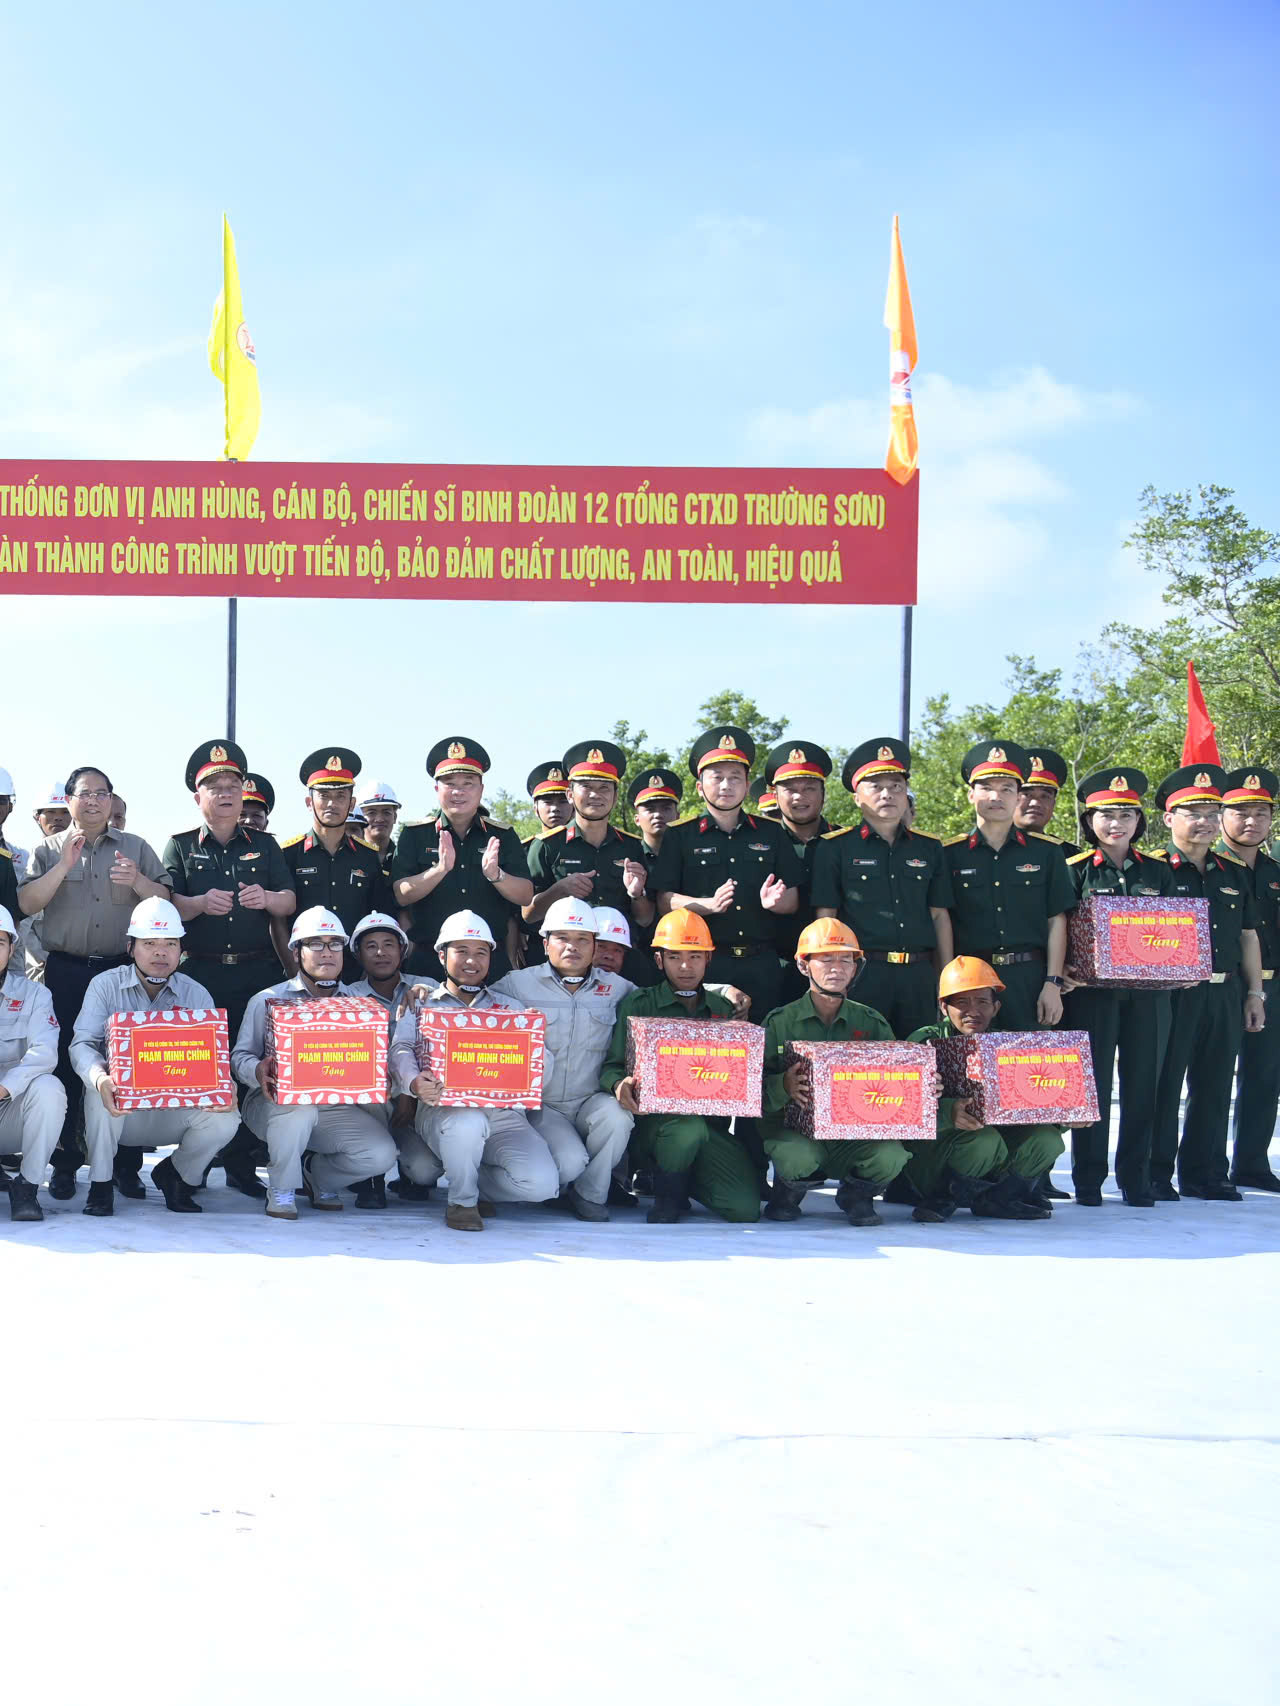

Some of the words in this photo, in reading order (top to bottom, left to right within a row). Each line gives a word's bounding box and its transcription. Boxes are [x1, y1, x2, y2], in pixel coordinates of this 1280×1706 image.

[0, 474, 67, 516] THỐNG
[75, 483, 118, 517] ĐƠN
[126, 487, 144, 524] VỊ
[152, 487, 195, 518] ANH
[202, 481, 265, 522] HÙNG,
[274, 482, 316, 519] CÁN
[323, 482, 356, 527] BỘ,
[364, 480, 427, 520] CHIẾN
[434, 485, 456, 521] SĨ
[462, 491, 512, 522] BINH
[518, 485, 576, 523] ĐOÀN
[584, 492, 608, 523] 12
[616, 480, 678, 527] (TỔNG
[685, 493, 738, 524] CTXD
[744, 486, 827, 525] TRƯỜNG
[834, 492, 885, 529] SƠN)
[35, 536, 104, 573] THÀNH
[112, 537, 168, 574] CÔNG
[176, 537, 237, 574] TRÌNH
[245, 541, 297, 582] VƯỢT
[303, 536, 349, 576] TIẾN
[356, 539, 390, 584] ĐỘ,
[398, 536, 439, 578] BẢO
[446, 536, 493, 578] ĐẢM
[501, 537, 554, 579] CHẤT
[561, 546, 635, 587] LƯỢNG,
[642, 549, 671, 580] AN
[678, 544, 738, 584] TOÀN,
[746, 544, 793, 589] HIỆU
[800, 541, 842, 585] QUẢ
[138, 1051, 161, 1064] PHẠM
[164, 1050, 185, 1061] MINH
[187, 1048, 211, 1061] CHÍNH
[298, 1052, 320, 1064] PHẠM
[323, 1052, 344, 1063] MINH
[345, 1050, 369, 1063] CHÍNH
[452, 1052, 475, 1065] PHẠM
[477, 1052, 498, 1064] MINH
[500, 1052, 524, 1065] CHÍNH
[162, 1065, 187, 1076] Tặng
[475, 1067, 499, 1078] Tặng
[689, 1066, 730, 1083] Tặng
[1029, 1075, 1067, 1089] Tặng
[864, 1092, 904, 1107] Tặng
